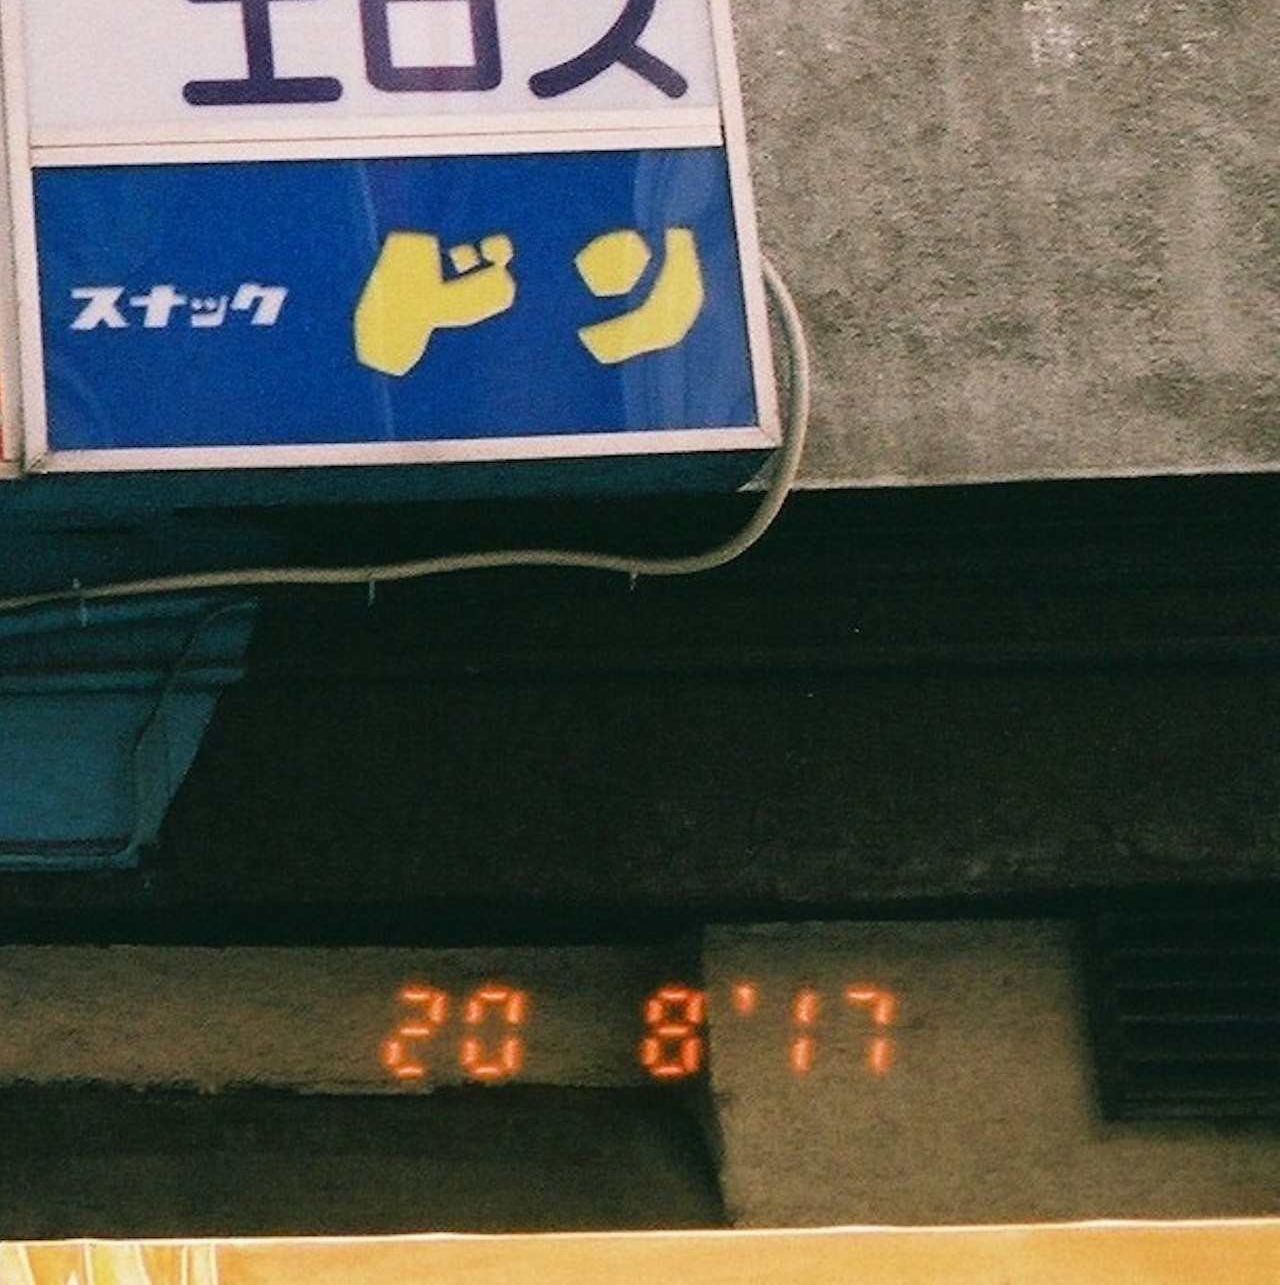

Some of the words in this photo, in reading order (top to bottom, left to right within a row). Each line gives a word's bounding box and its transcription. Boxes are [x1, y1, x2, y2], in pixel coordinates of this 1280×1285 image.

[68, 283, 289, 331] スナック
[352, 227, 706, 378] ドン
